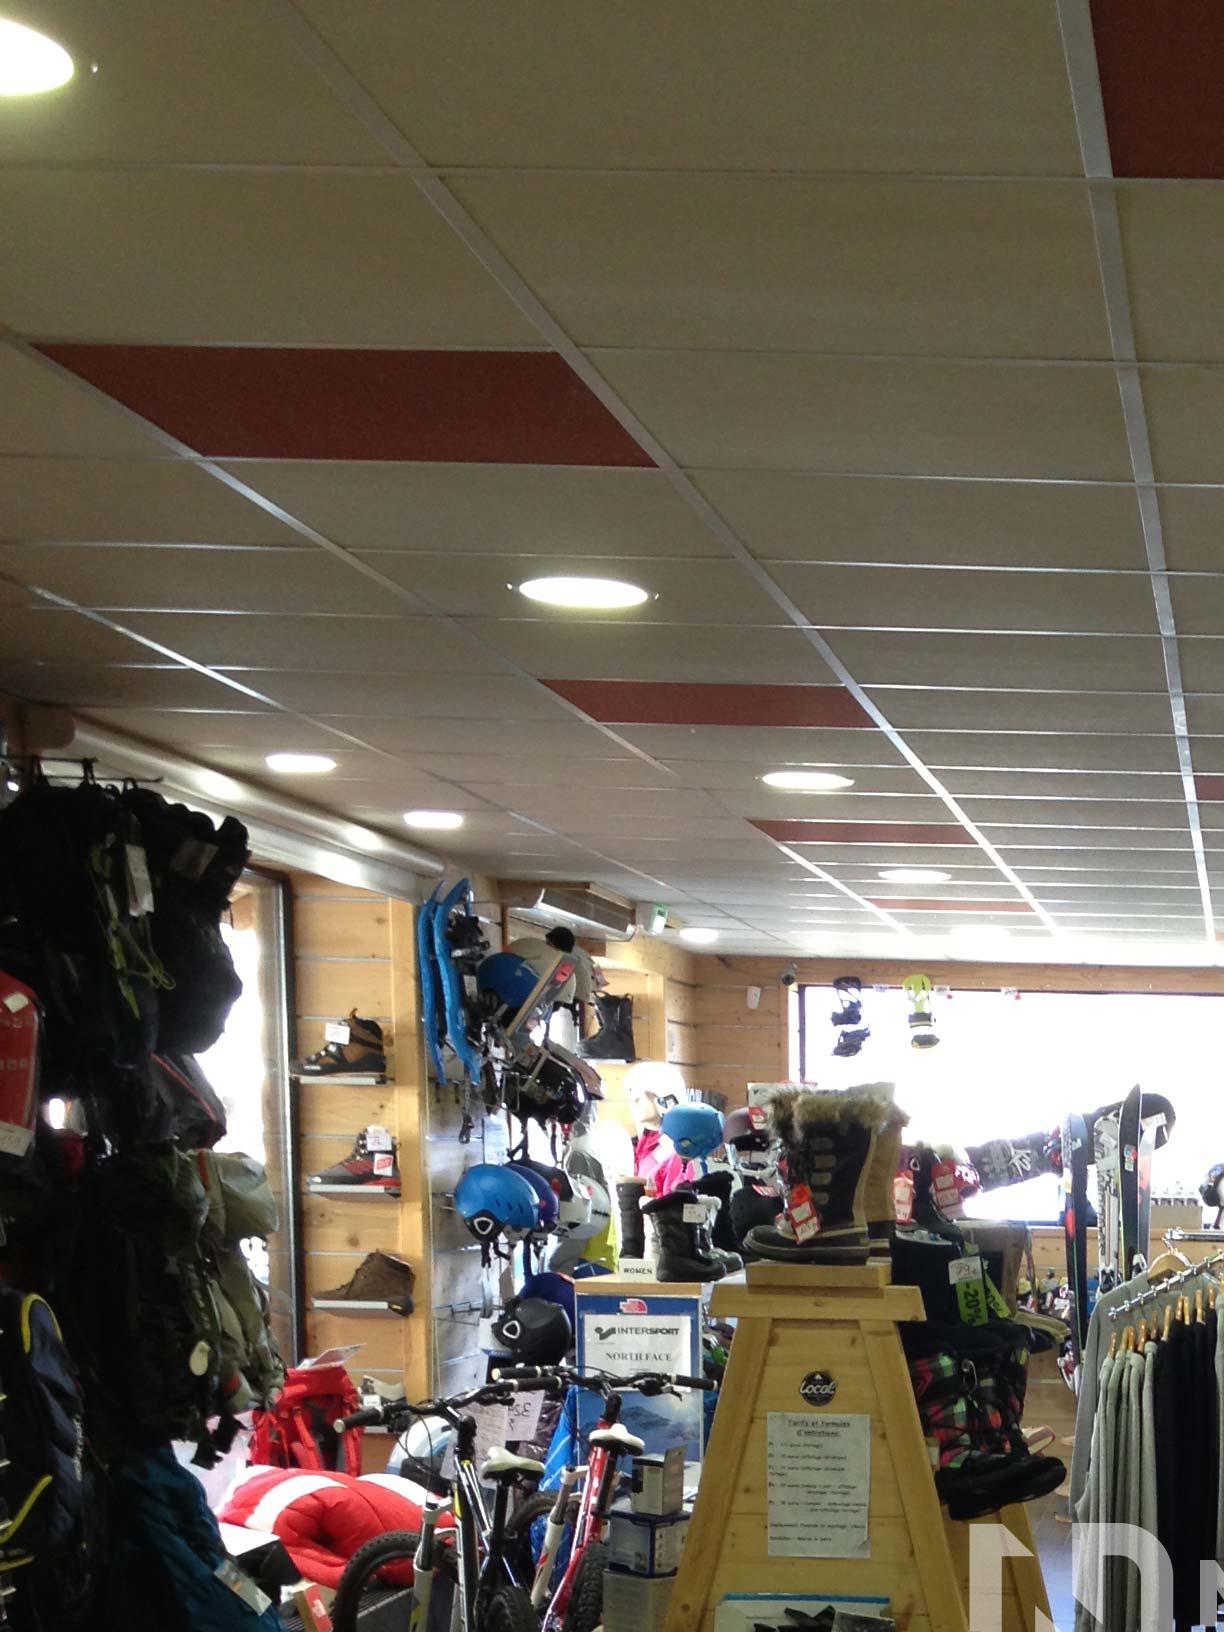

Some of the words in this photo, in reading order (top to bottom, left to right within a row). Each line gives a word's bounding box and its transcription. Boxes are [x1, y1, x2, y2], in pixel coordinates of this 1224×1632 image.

[623, 1267, 653, 1275] WOMEN
[616, 1326, 680, 1336] INTERSPORT
[605, 1351, 643, 1361] NORTH
[645, 1352, 672, 1361] FACE
